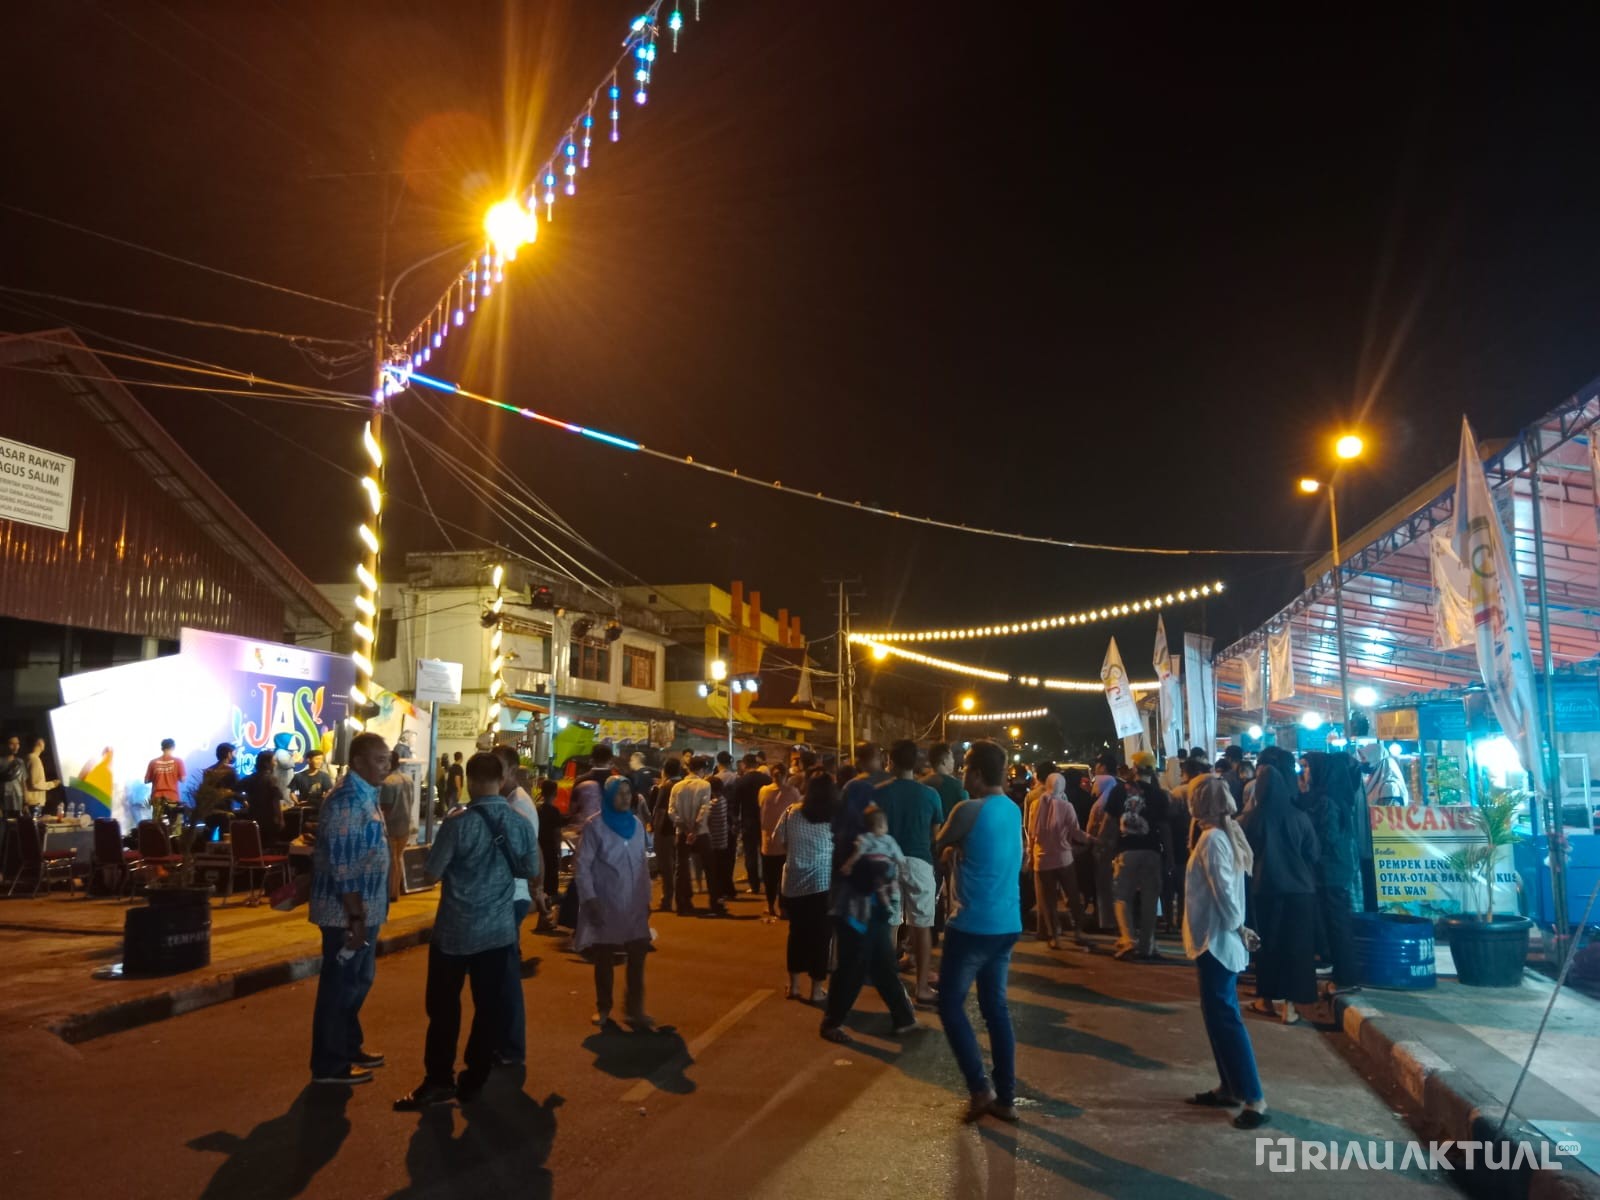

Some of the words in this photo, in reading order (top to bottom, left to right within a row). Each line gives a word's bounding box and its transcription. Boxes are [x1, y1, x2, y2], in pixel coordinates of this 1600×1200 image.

[28, 454, 66, 473] RAKYAT
[28, 469, 60, 486] SALIM
[1379, 860, 1421, 869] PEMPEK
[1380, 873, 1438, 882] OTAK-OTAK
[1381, 886, 1401, 895] TEK
[1404, 886, 1427, 895] WAN
